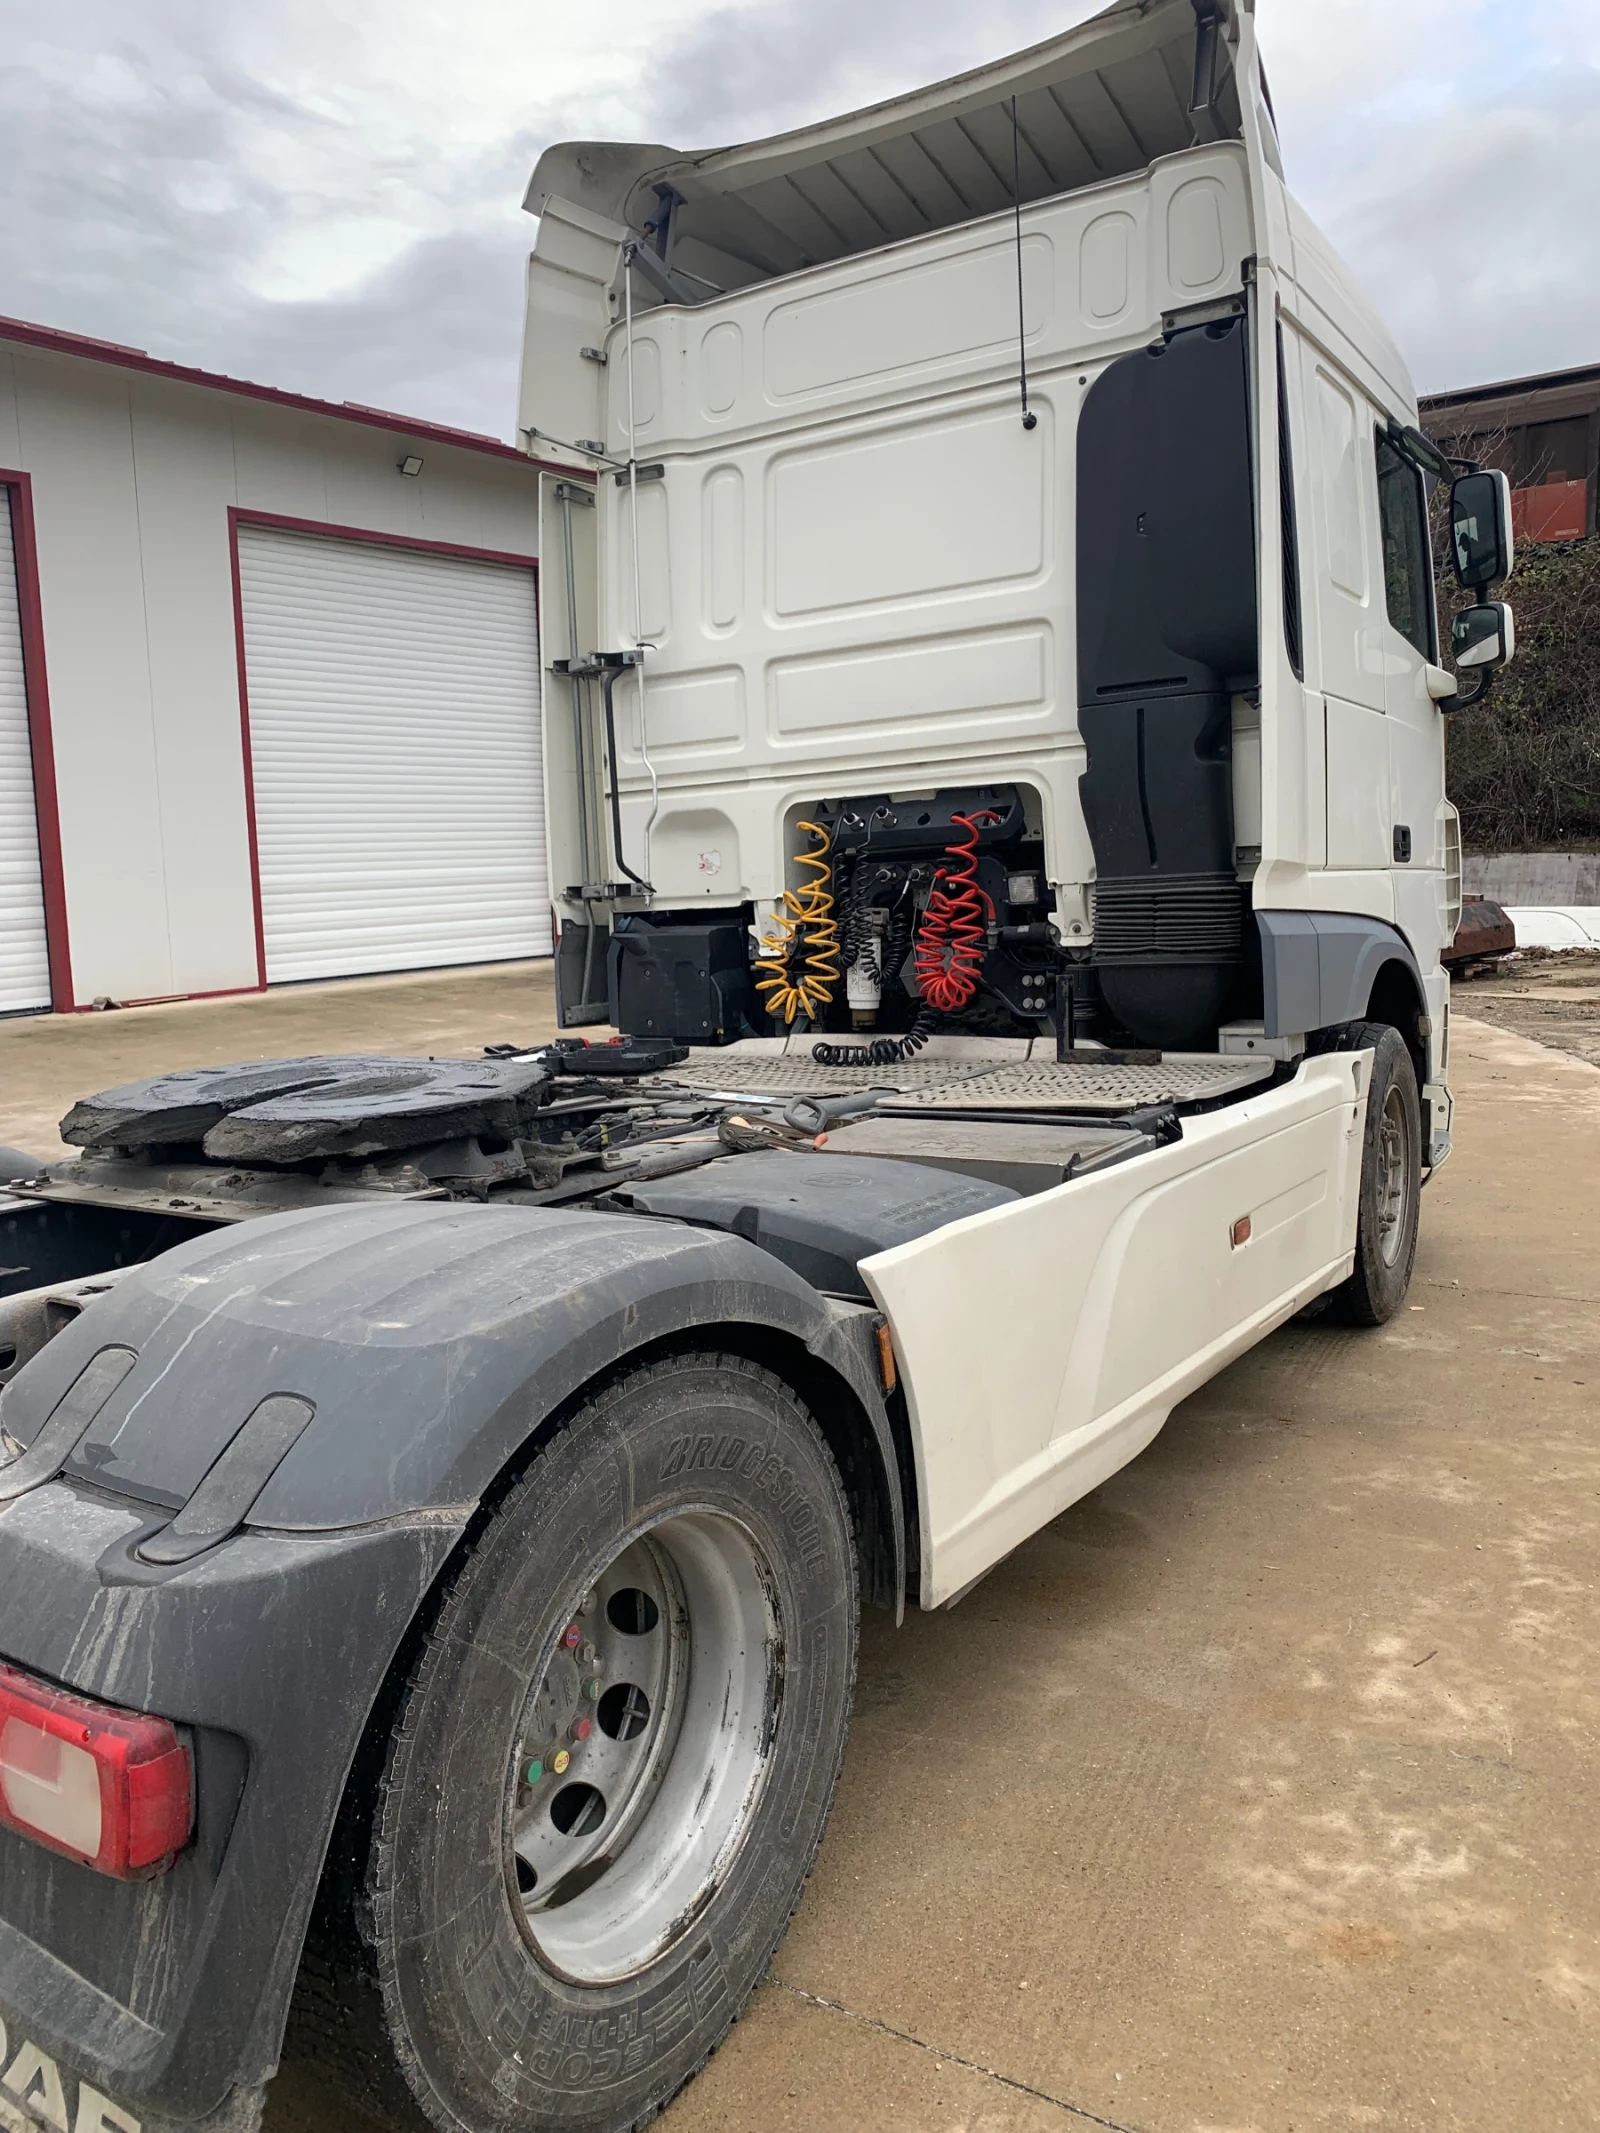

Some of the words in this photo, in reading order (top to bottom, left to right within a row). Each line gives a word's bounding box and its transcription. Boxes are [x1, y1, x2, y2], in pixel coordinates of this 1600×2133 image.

[660, 1434, 828, 1582] BRIDGESTONE
[0, 2016, 142, 2133] AF
[539, 2008, 639, 2048] H-DRIVE
